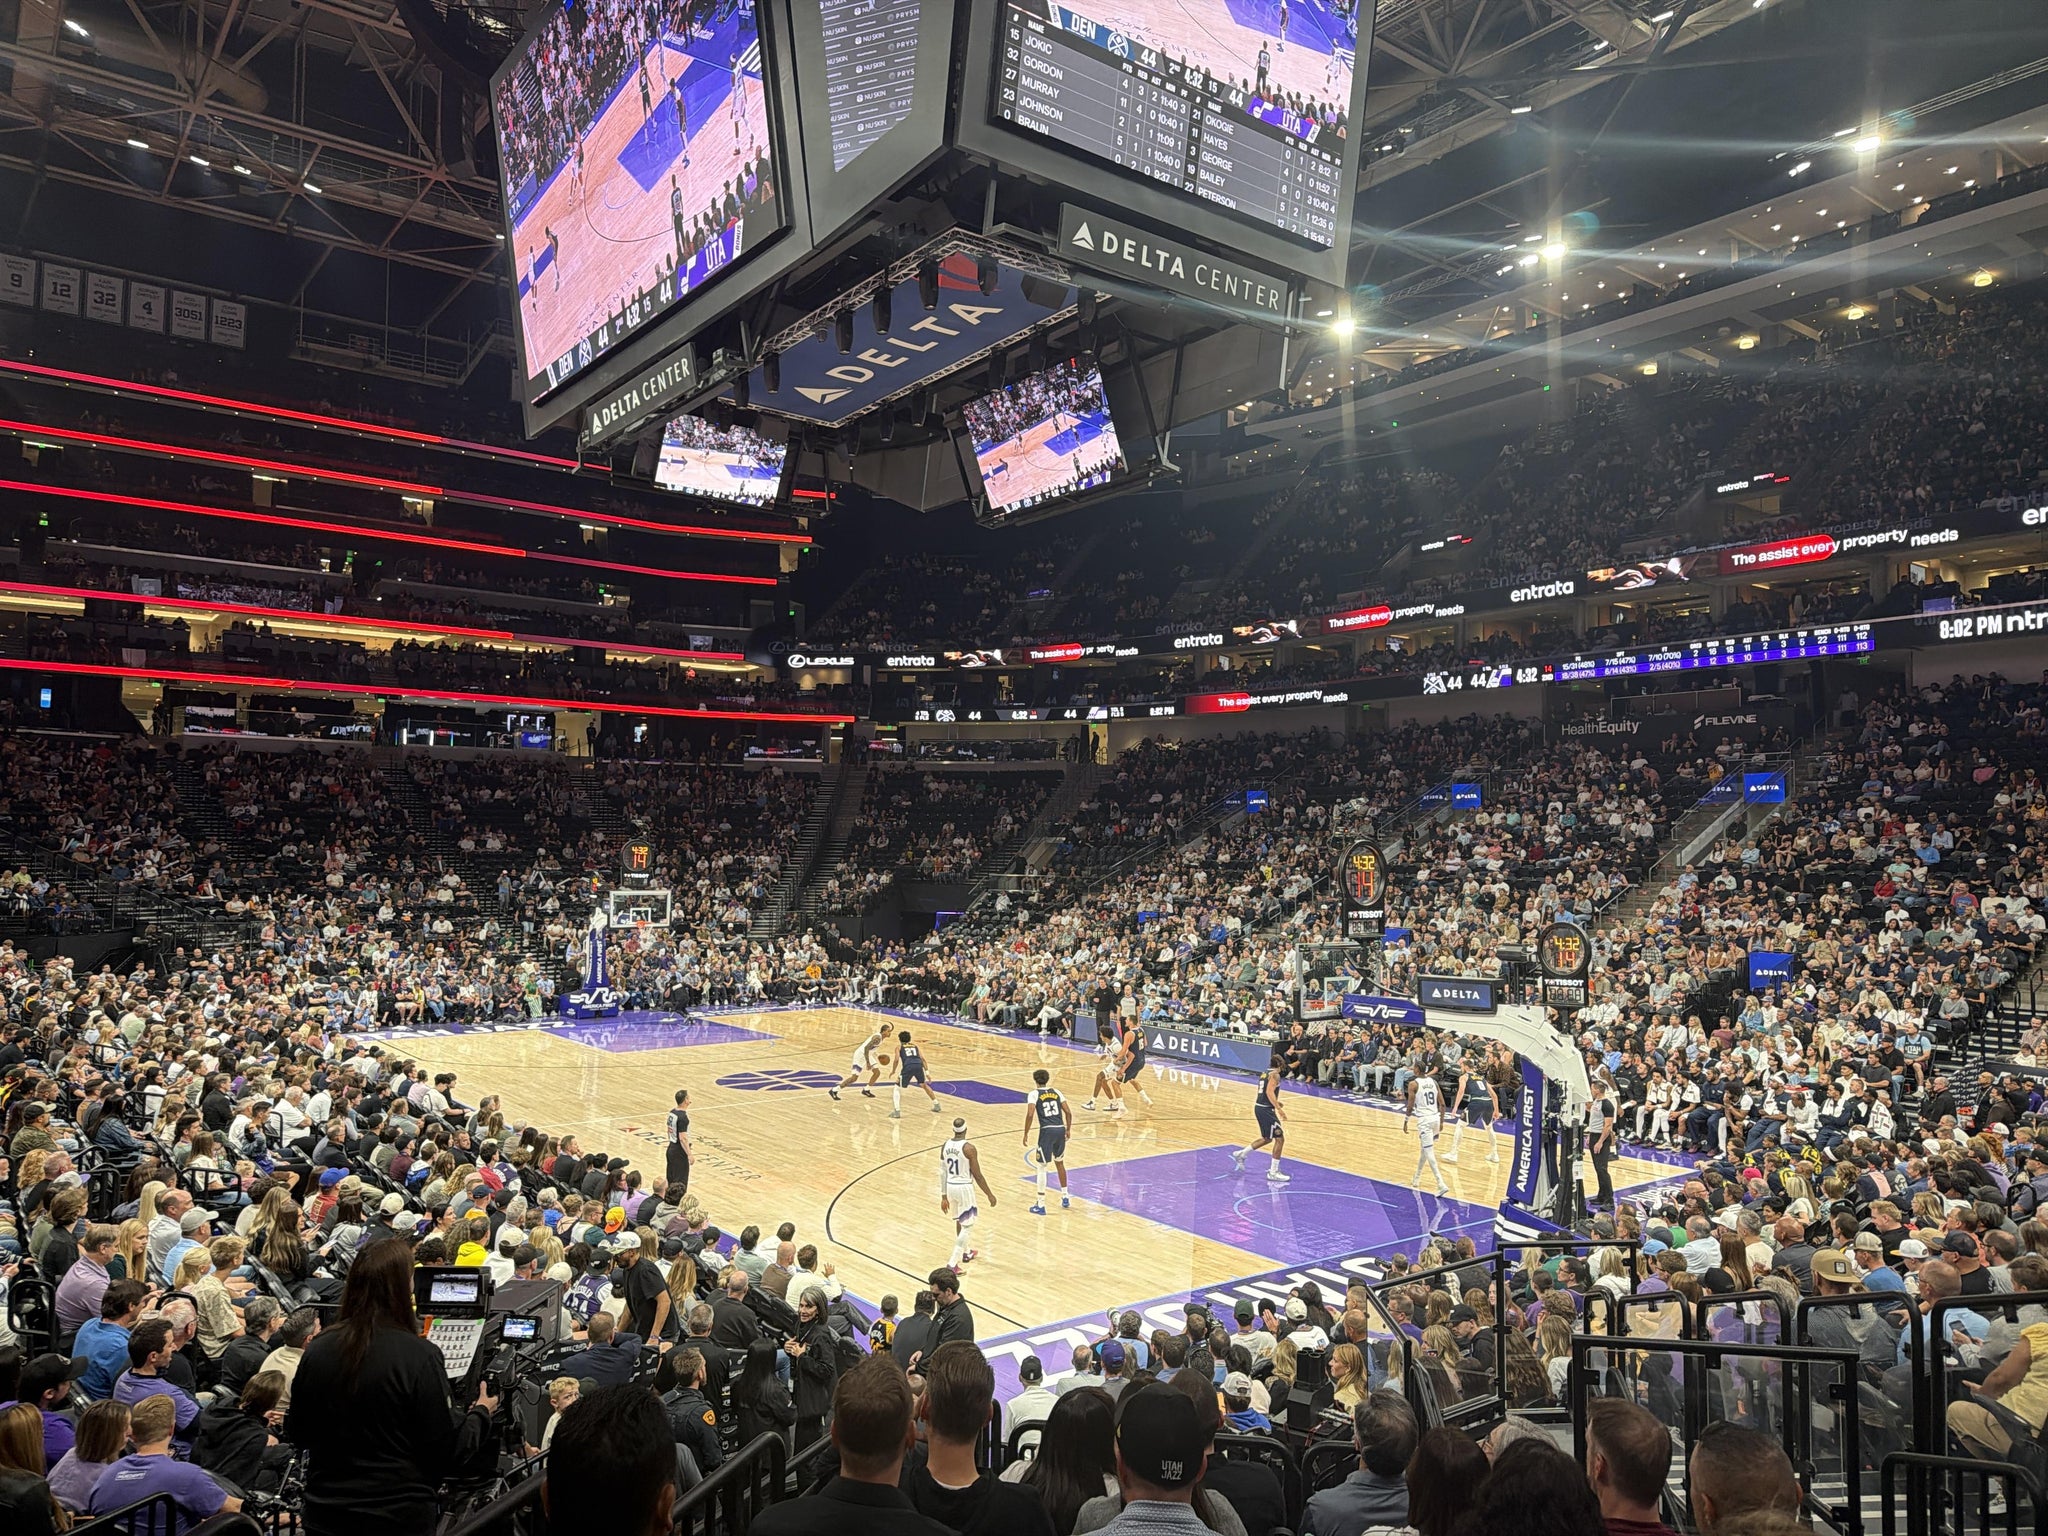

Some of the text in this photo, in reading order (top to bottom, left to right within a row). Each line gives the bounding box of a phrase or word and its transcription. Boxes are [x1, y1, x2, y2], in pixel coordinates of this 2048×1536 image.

[1010, 28, 1020, 41] 15
[1025, 35, 1053, 55] JOKIC
[1161, 95, 1178, 111] 11:40
[1071, 13, 1097, 40] DEN
[1141, 48, 1156, 67] 44
[1184, 68, 1204, 90] 4:32
[1208, 80, 1218, 93] 15
[1229, 89, 1243, 109] 44
[1281, 110, 1301, 134] UTA
[1005, 68, 1017, 81] 27
[1021, 74, 1060, 99] MURRAY
[1007, 48, 1019, 61] 32
[1023, 55, 1063, 80] GORDON
[1158, 114, 1178, 130] 10:40
[1003, 88, 1015, 101] 23
[1019, 95, 1063, 122] JOHNSON
[1154, 150, 1174, 166] 10:40
[1004, 109, 1011, 120] 0
[1018, 115, 1050, 136] BRAUN
[1193, 110, 1201, 121] 21
[1205, 115, 1235, 136] OKOGIE
[1192, 128, 1199, 138] 11
[1203, 133, 1229, 151] HAYES
[1190, 145, 1196, 156] 3
[1201, 151, 1233, 172] GEORGE
[1187, 164, 1196, 175] 19
[1200, 169, 1226, 187] BAILEY
[1184, 182, 1195, 193] 22
[1197, 187, 1237, 210] PETERSON
[10, 273, 23, 288] 9
[1102, 230, 1280, 311] DELTA CENTER
[51, 281, 71, 299] 12
[93, 290, 117, 308] 32
[142, 301, 153, 316] 4
[558, 350, 573, 377] DEN
[598, 325, 609, 349] 44
[626, 302, 641, 329] 4:32
[643, 296, 652, 314] 15
[660, 278, 672, 304] 44
[704, 236, 727, 271] UTA
[214, 316, 243, 330] 1223
[825, 303, 1004, 383] DELTA
[602, 357, 691, 427] DELTA CENTER
[1717, 481, 1749, 494] entrata
[1421, 540, 1445, 551] entrata
[1732, 528, 1959, 567] The assist every property needs
[1511, 579, 1575, 602] entrata
[1329, 603, 1465, 629] The assist every property needs
[1939, 619, 1973, 639] 8:02
[1976, 614, 2003, 635] PM
[1174, 633, 1223, 650] entrata
[802, 656, 855, 668] LEXUS
[887, 654, 935, 667] entrata
[1030, 650, 1043, 660] The
[1115, 646, 1139, 657] needs
[1447, 675, 1463, 690] 44
[1470, 673, 1487, 688] 44
[1516, 667, 1538, 683] 4:32
[1218, 689, 1348, 706] The assist every property needs
[969, 711, 982, 720] 44
[1064, 709, 1077, 719] 44
[1561, 714, 1757, 736] HealthEquity FILEVINE
[1353, 855, 1375, 870] 4:32
[1356, 872, 1374, 898] 14
[1358, 910, 1384, 919] TISSOT
[1555, 936, 1580, 951] 4:32
[1557, 952, 1576, 969] 14
[1443, 988, 1480, 1000] DELTA
[1552, 979, 1584, 988] TISSOT
[1168, 1034, 1220, 1059] DELTA
[1043, 1101, 1060, 1117] 23
[1424, 1091, 1435, 1106] 19
[1516, 1089, 1535, 1193] AMERICA FIRST
[947, 1158, 960, 1176] 21
[1161, 1459, 1183, 1471] UTAH
[1161, 1470, 1182, 1480] JAZZ
